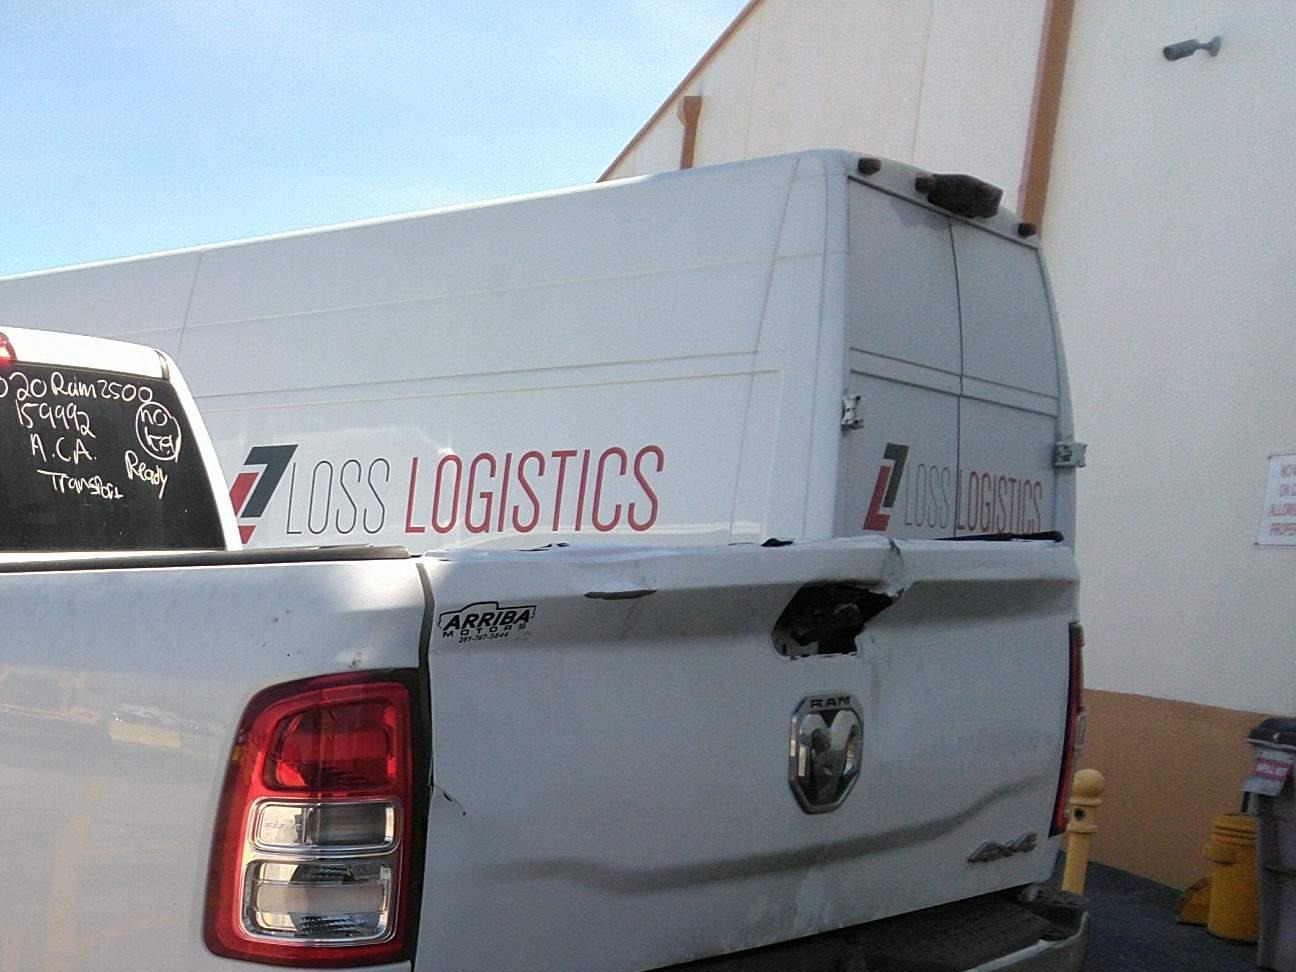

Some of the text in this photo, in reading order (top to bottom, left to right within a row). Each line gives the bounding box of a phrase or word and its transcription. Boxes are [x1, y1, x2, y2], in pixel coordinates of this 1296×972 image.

[50, 371, 98, 398] Ram
[124, 450, 169, 500] Ready
[286, 444, 665, 535] LOSS LOGISTICS
[904, 463, 1043, 533] LOSS LOGISTICS
[442, 608, 531, 632] ARRIBA
[442, 623, 527, 639] MOTORS
[810, 695, 851, 709] RAM
